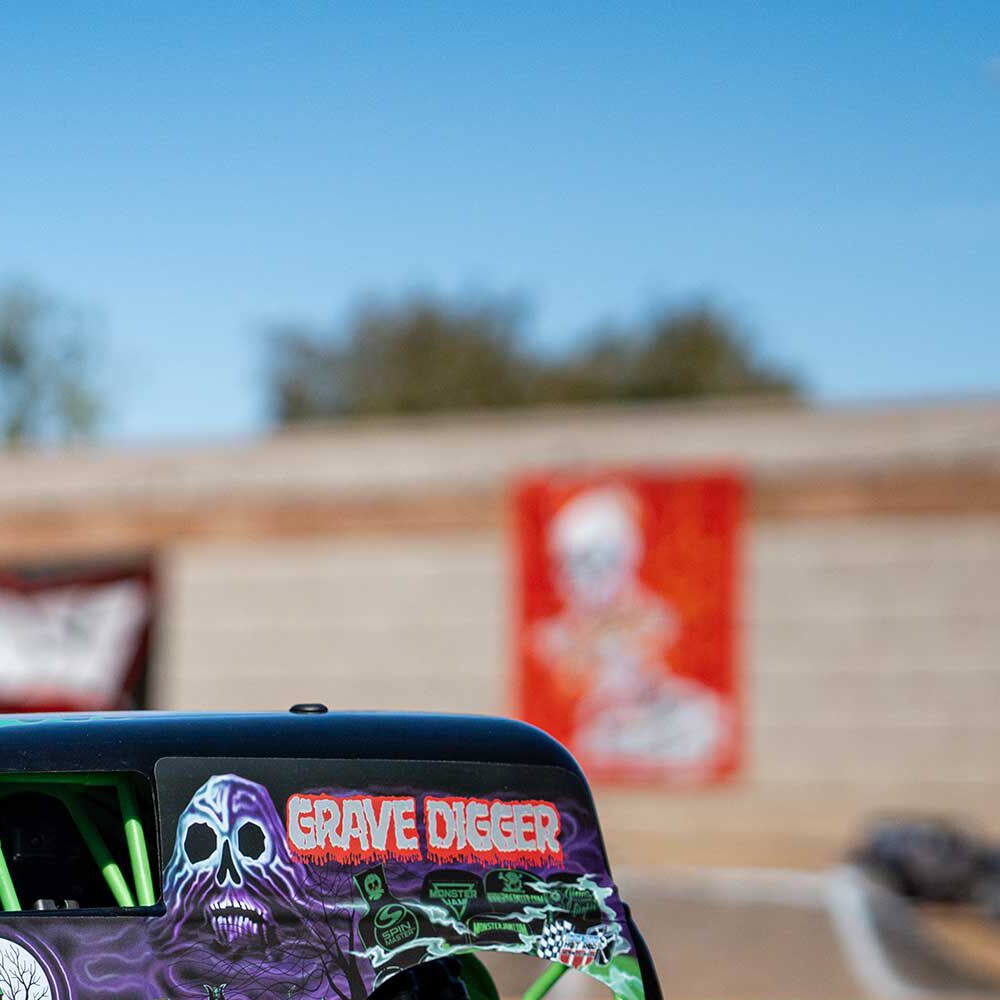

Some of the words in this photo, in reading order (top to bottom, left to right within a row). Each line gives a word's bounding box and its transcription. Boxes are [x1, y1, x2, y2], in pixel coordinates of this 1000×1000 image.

[288, 796, 419, 852] GRAVE
[425, 798, 561, 854] DIGGER
[429, 888, 477, 898] MONSTER
[381, 921, 412, 938] SPIN
